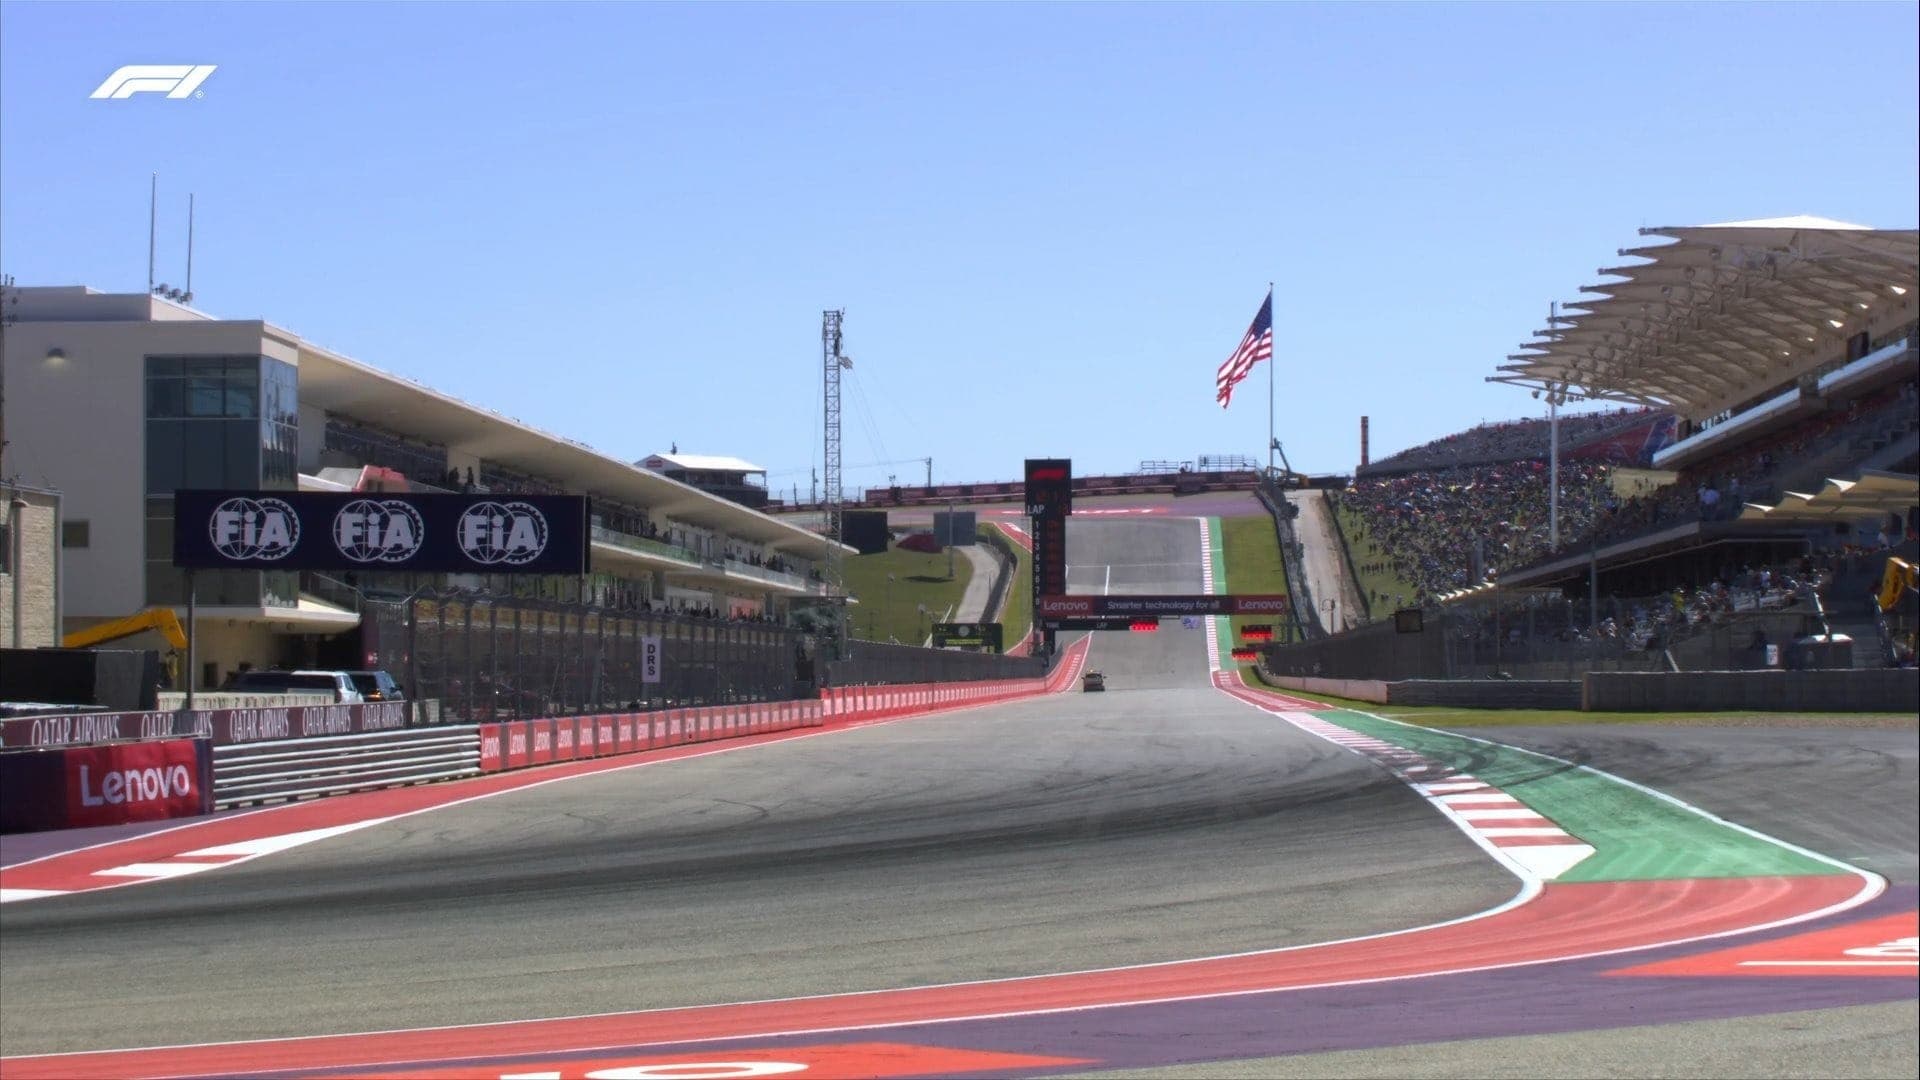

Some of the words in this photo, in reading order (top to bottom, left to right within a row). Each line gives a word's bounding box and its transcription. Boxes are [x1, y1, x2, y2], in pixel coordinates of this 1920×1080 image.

[1027, 504, 1045, 514] LAP
[1043, 601, 1089, 610] Lenovo
[1107, 601, 1142, 609] Smarter
[1145, 600, 1193, 610] technology
[1196, 600, 1208, 609] for
[1238, 600, 1283, 609] Lenovo
[647, 643, 656, 676] DRS
[32, 717, 72, 746] QATAR
[73, 715, 120, 744] AIRWAYS
[141, 713, 174, 738] QATAR
[230, 710, 258, 741] QATAR
[259, 708, 289, 738] AIRWAYS
[302, 707, 325, 736] QATAR
[326, 705, 351, 733] AIRWAYS
[362, 704, 381, 731] QATAR
[80, 764, 190, 807] Lenovo
